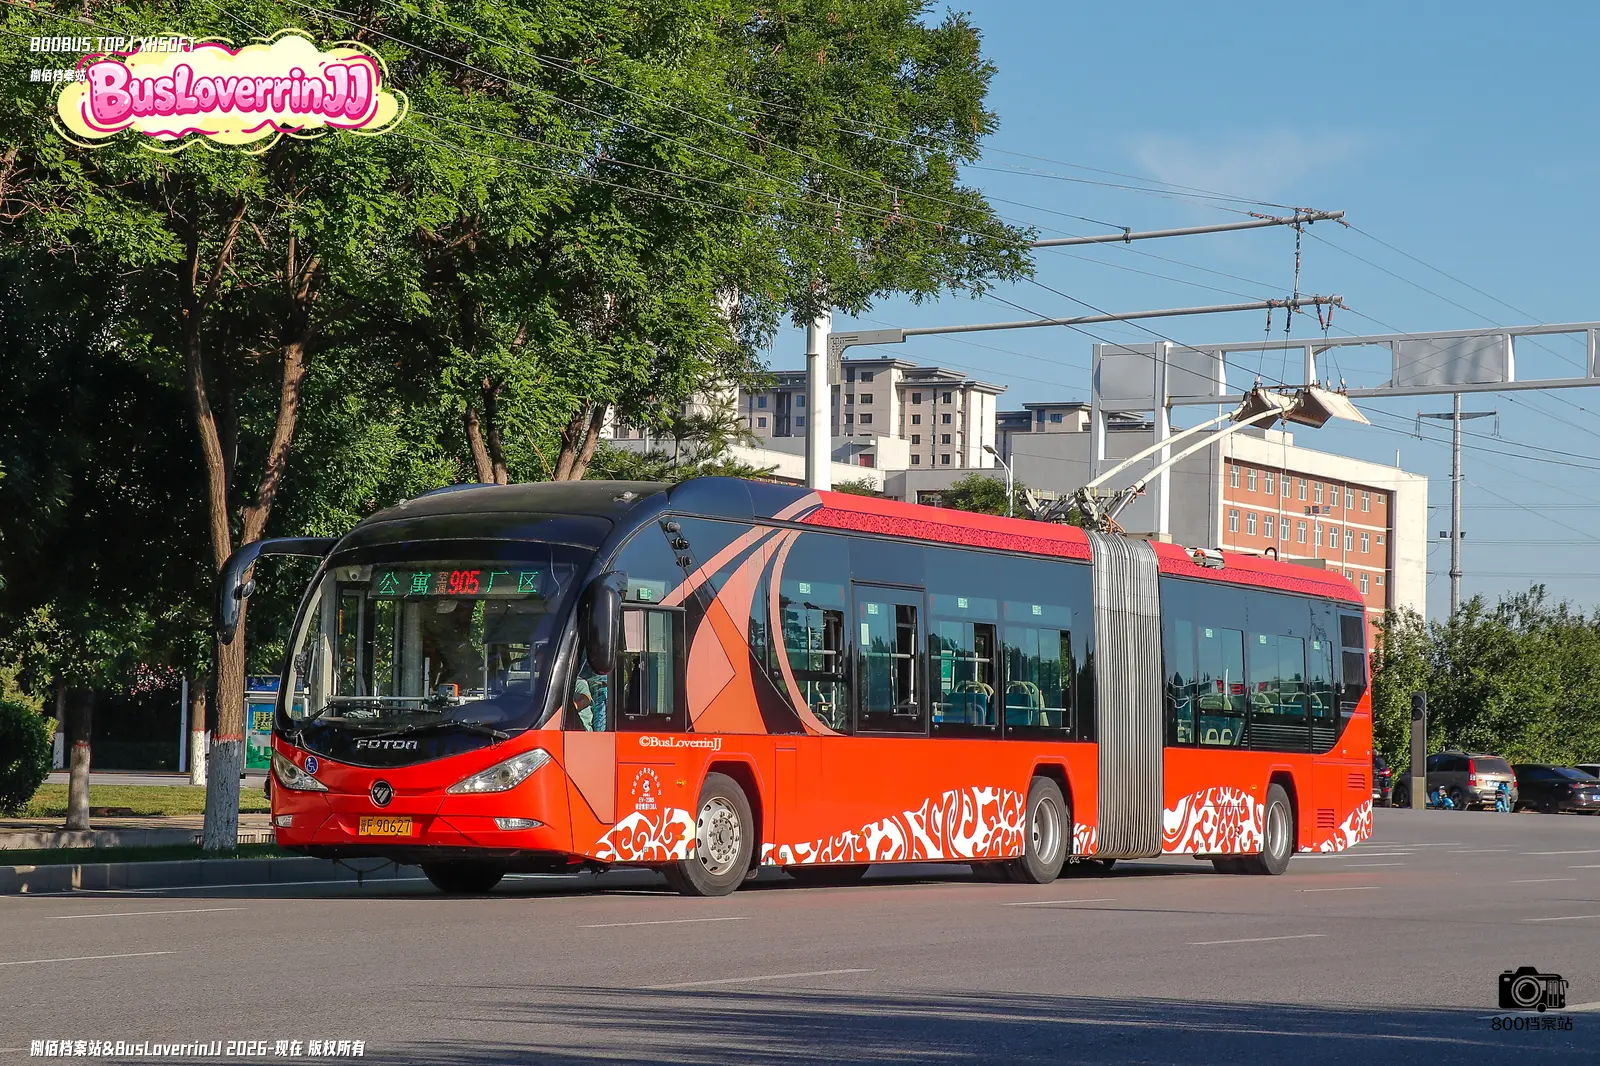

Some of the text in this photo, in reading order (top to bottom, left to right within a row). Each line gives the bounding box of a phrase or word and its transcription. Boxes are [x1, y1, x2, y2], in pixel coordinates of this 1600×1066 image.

[379, 570, 540, 596] 公寓 905 厂区
[434, 571, 449, 595] 空调
[356, 739, 418, 750] FOTON
